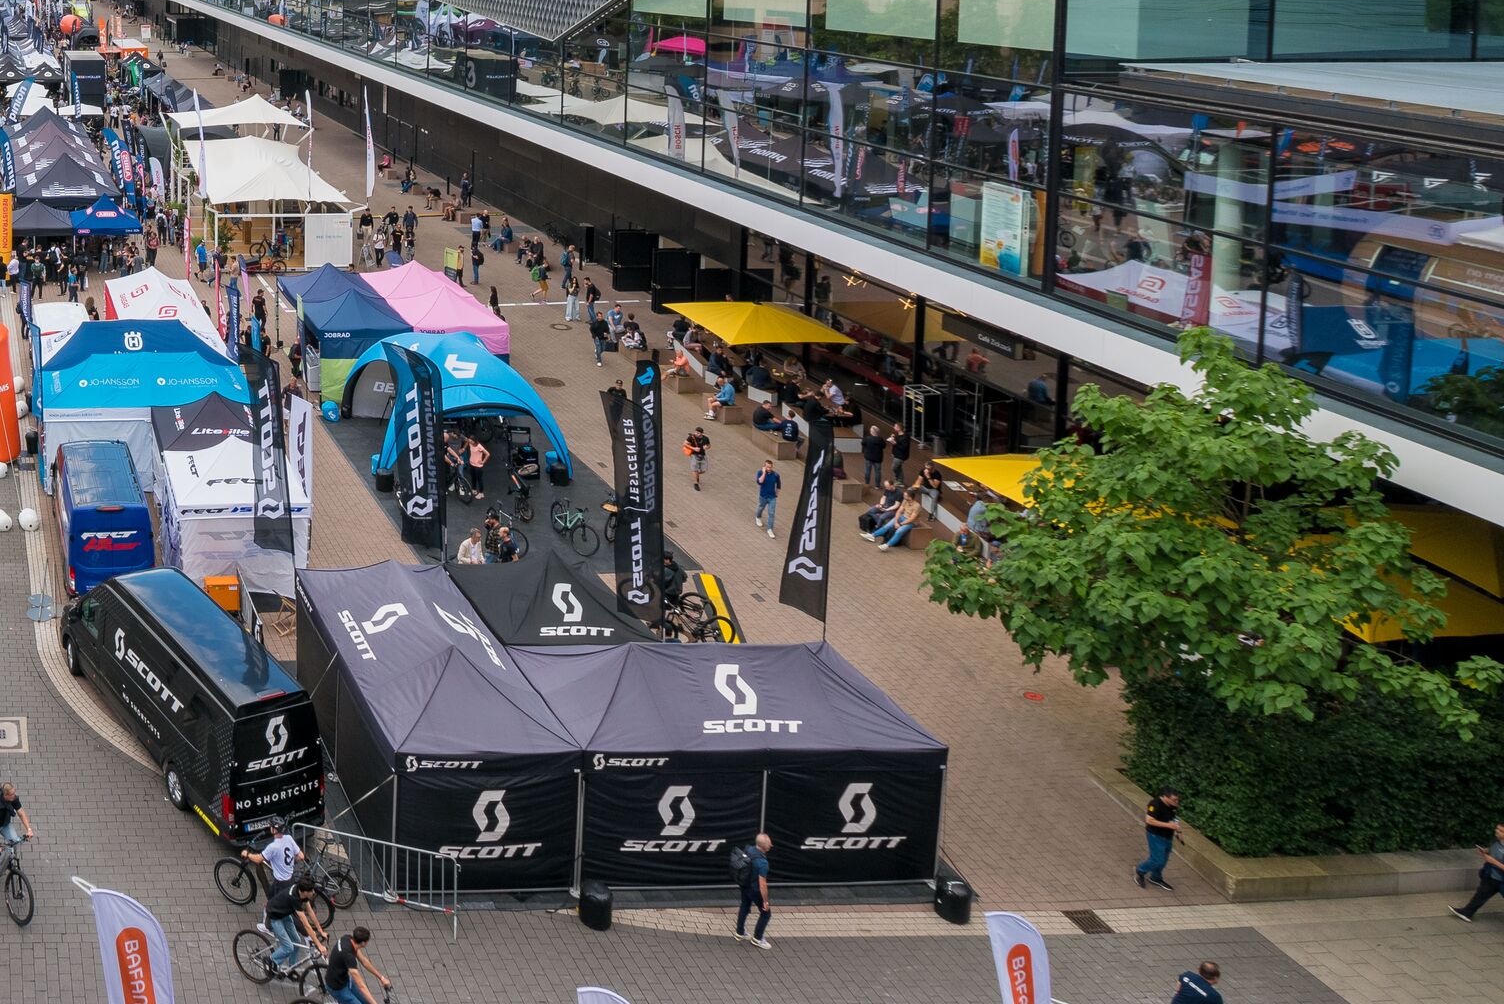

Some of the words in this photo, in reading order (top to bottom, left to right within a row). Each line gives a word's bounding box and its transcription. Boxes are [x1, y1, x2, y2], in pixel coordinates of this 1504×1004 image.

[9, 86, 27, 122] pinion
[165, 377, 218, 386] JOHANSSON
[181, 507, 229, 515] FELT
[80, 530, 137, 540] FELT
[337, 610, 376, 661] SCOTT
[539, 626, 615, 637] SCOTT
[125, 648, 184, 713] SCOTT
[702, 718, 803, 734] SCOTT
[246, 747, 308, 772] SCOTT
[419, 760, 483, 769] SCOTT
[607, 758, 669, 767] SCOTT
[236, 800, 251, 810] NO
[257, 779, 319, 806] SHORTCUTS
[620, 839, 727, 853] SCOTT
[800, 836, 907, 850] SCOTT
[439, 843, 542, 859] SCOTT
